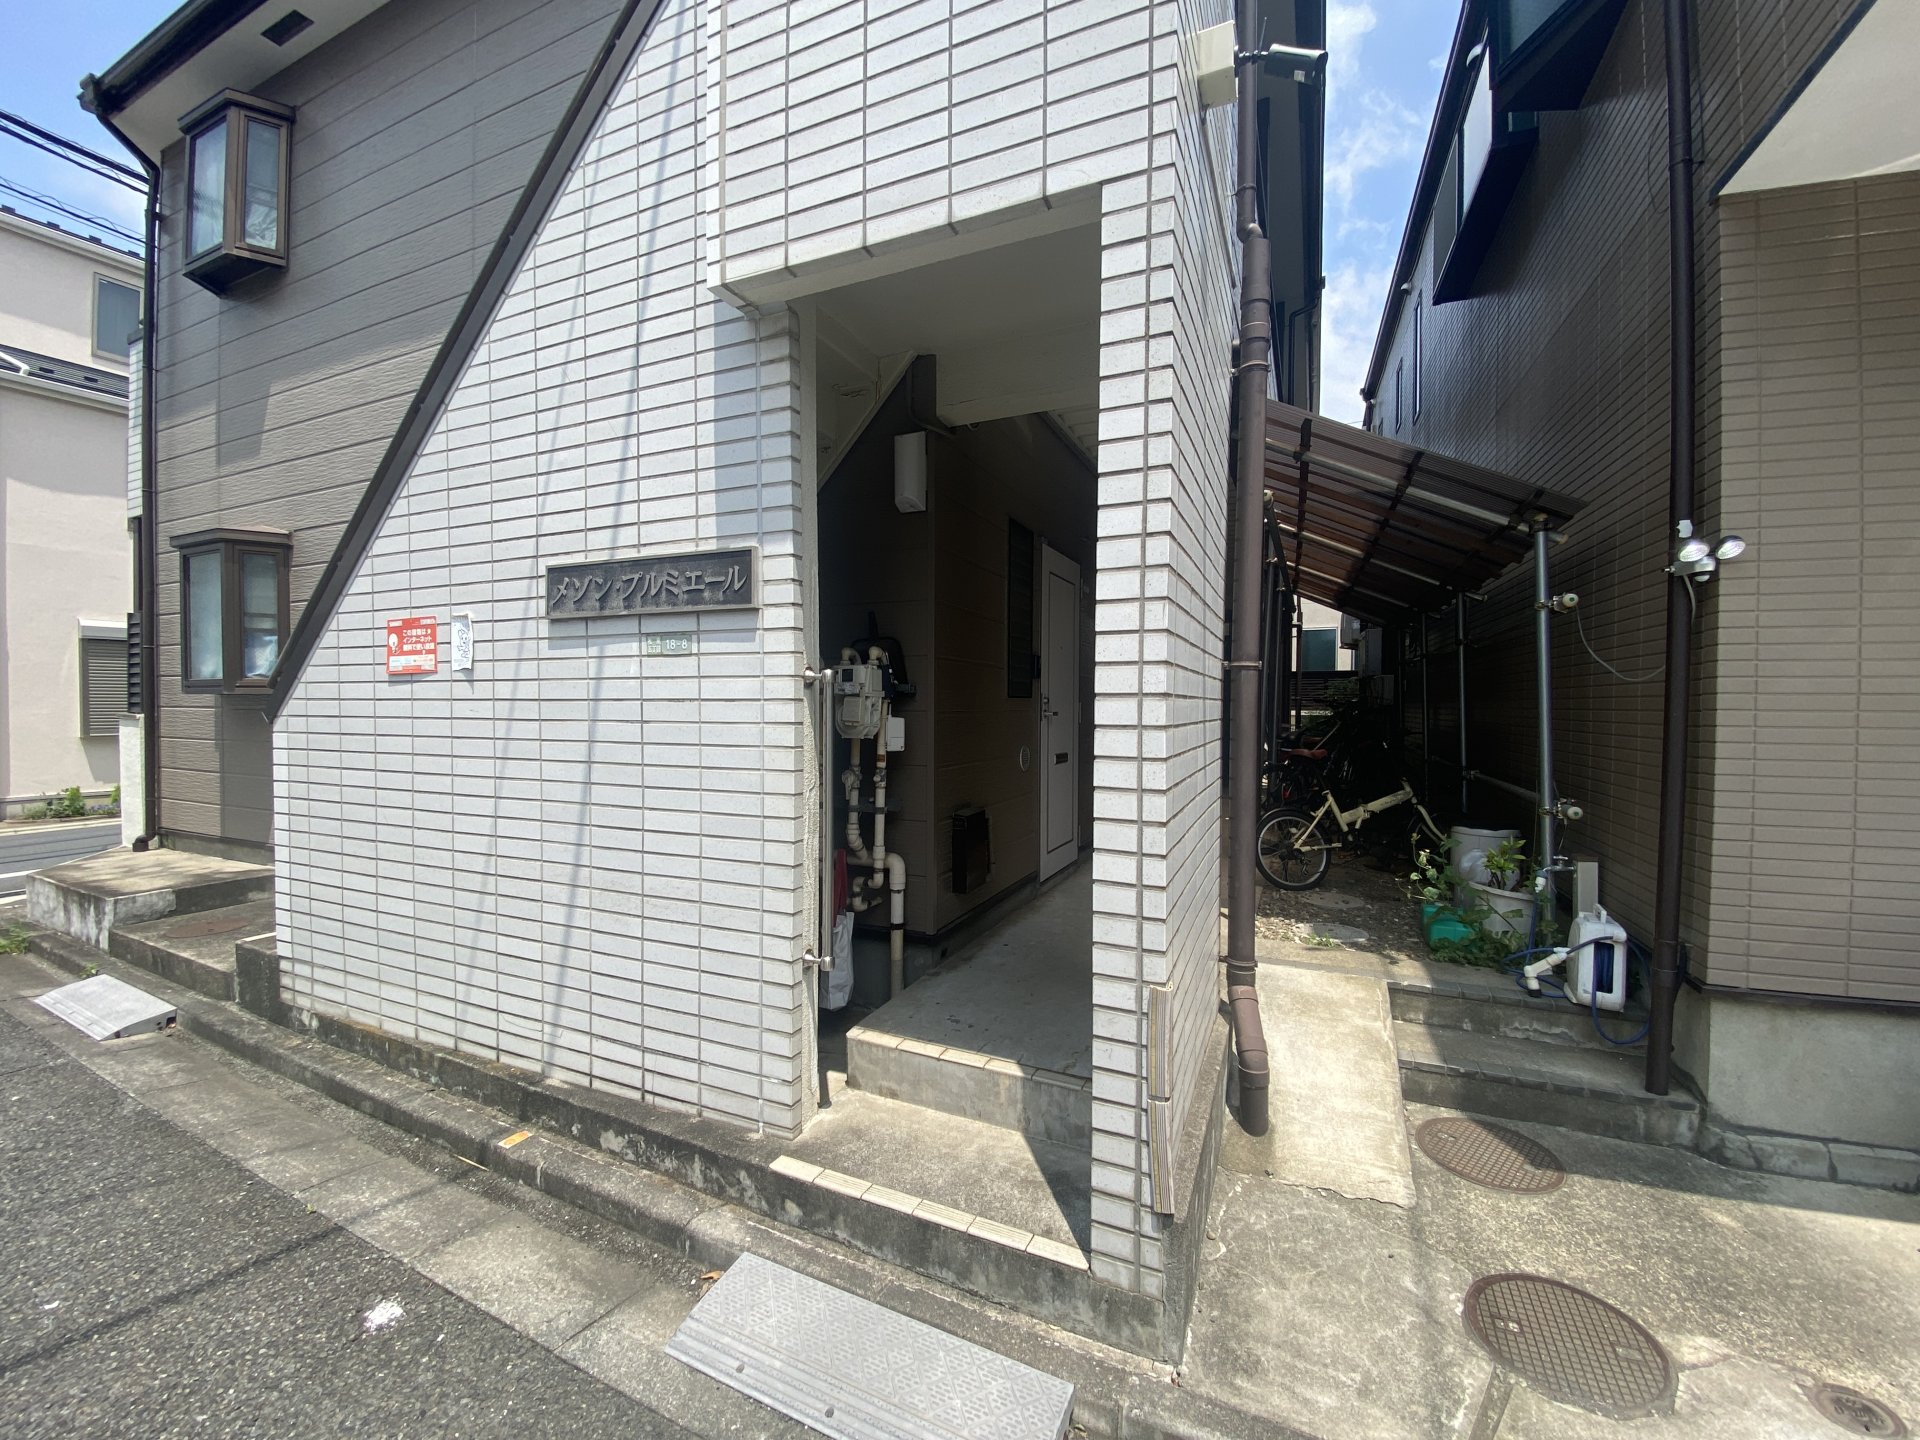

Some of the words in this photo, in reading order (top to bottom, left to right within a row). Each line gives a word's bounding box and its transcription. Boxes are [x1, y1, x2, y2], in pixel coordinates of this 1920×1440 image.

[551, 565, 747, 605] メゾン・プルミエール
[402, 635, 432, 643] インターネット
[665, 638, 688, 650] 18-8
